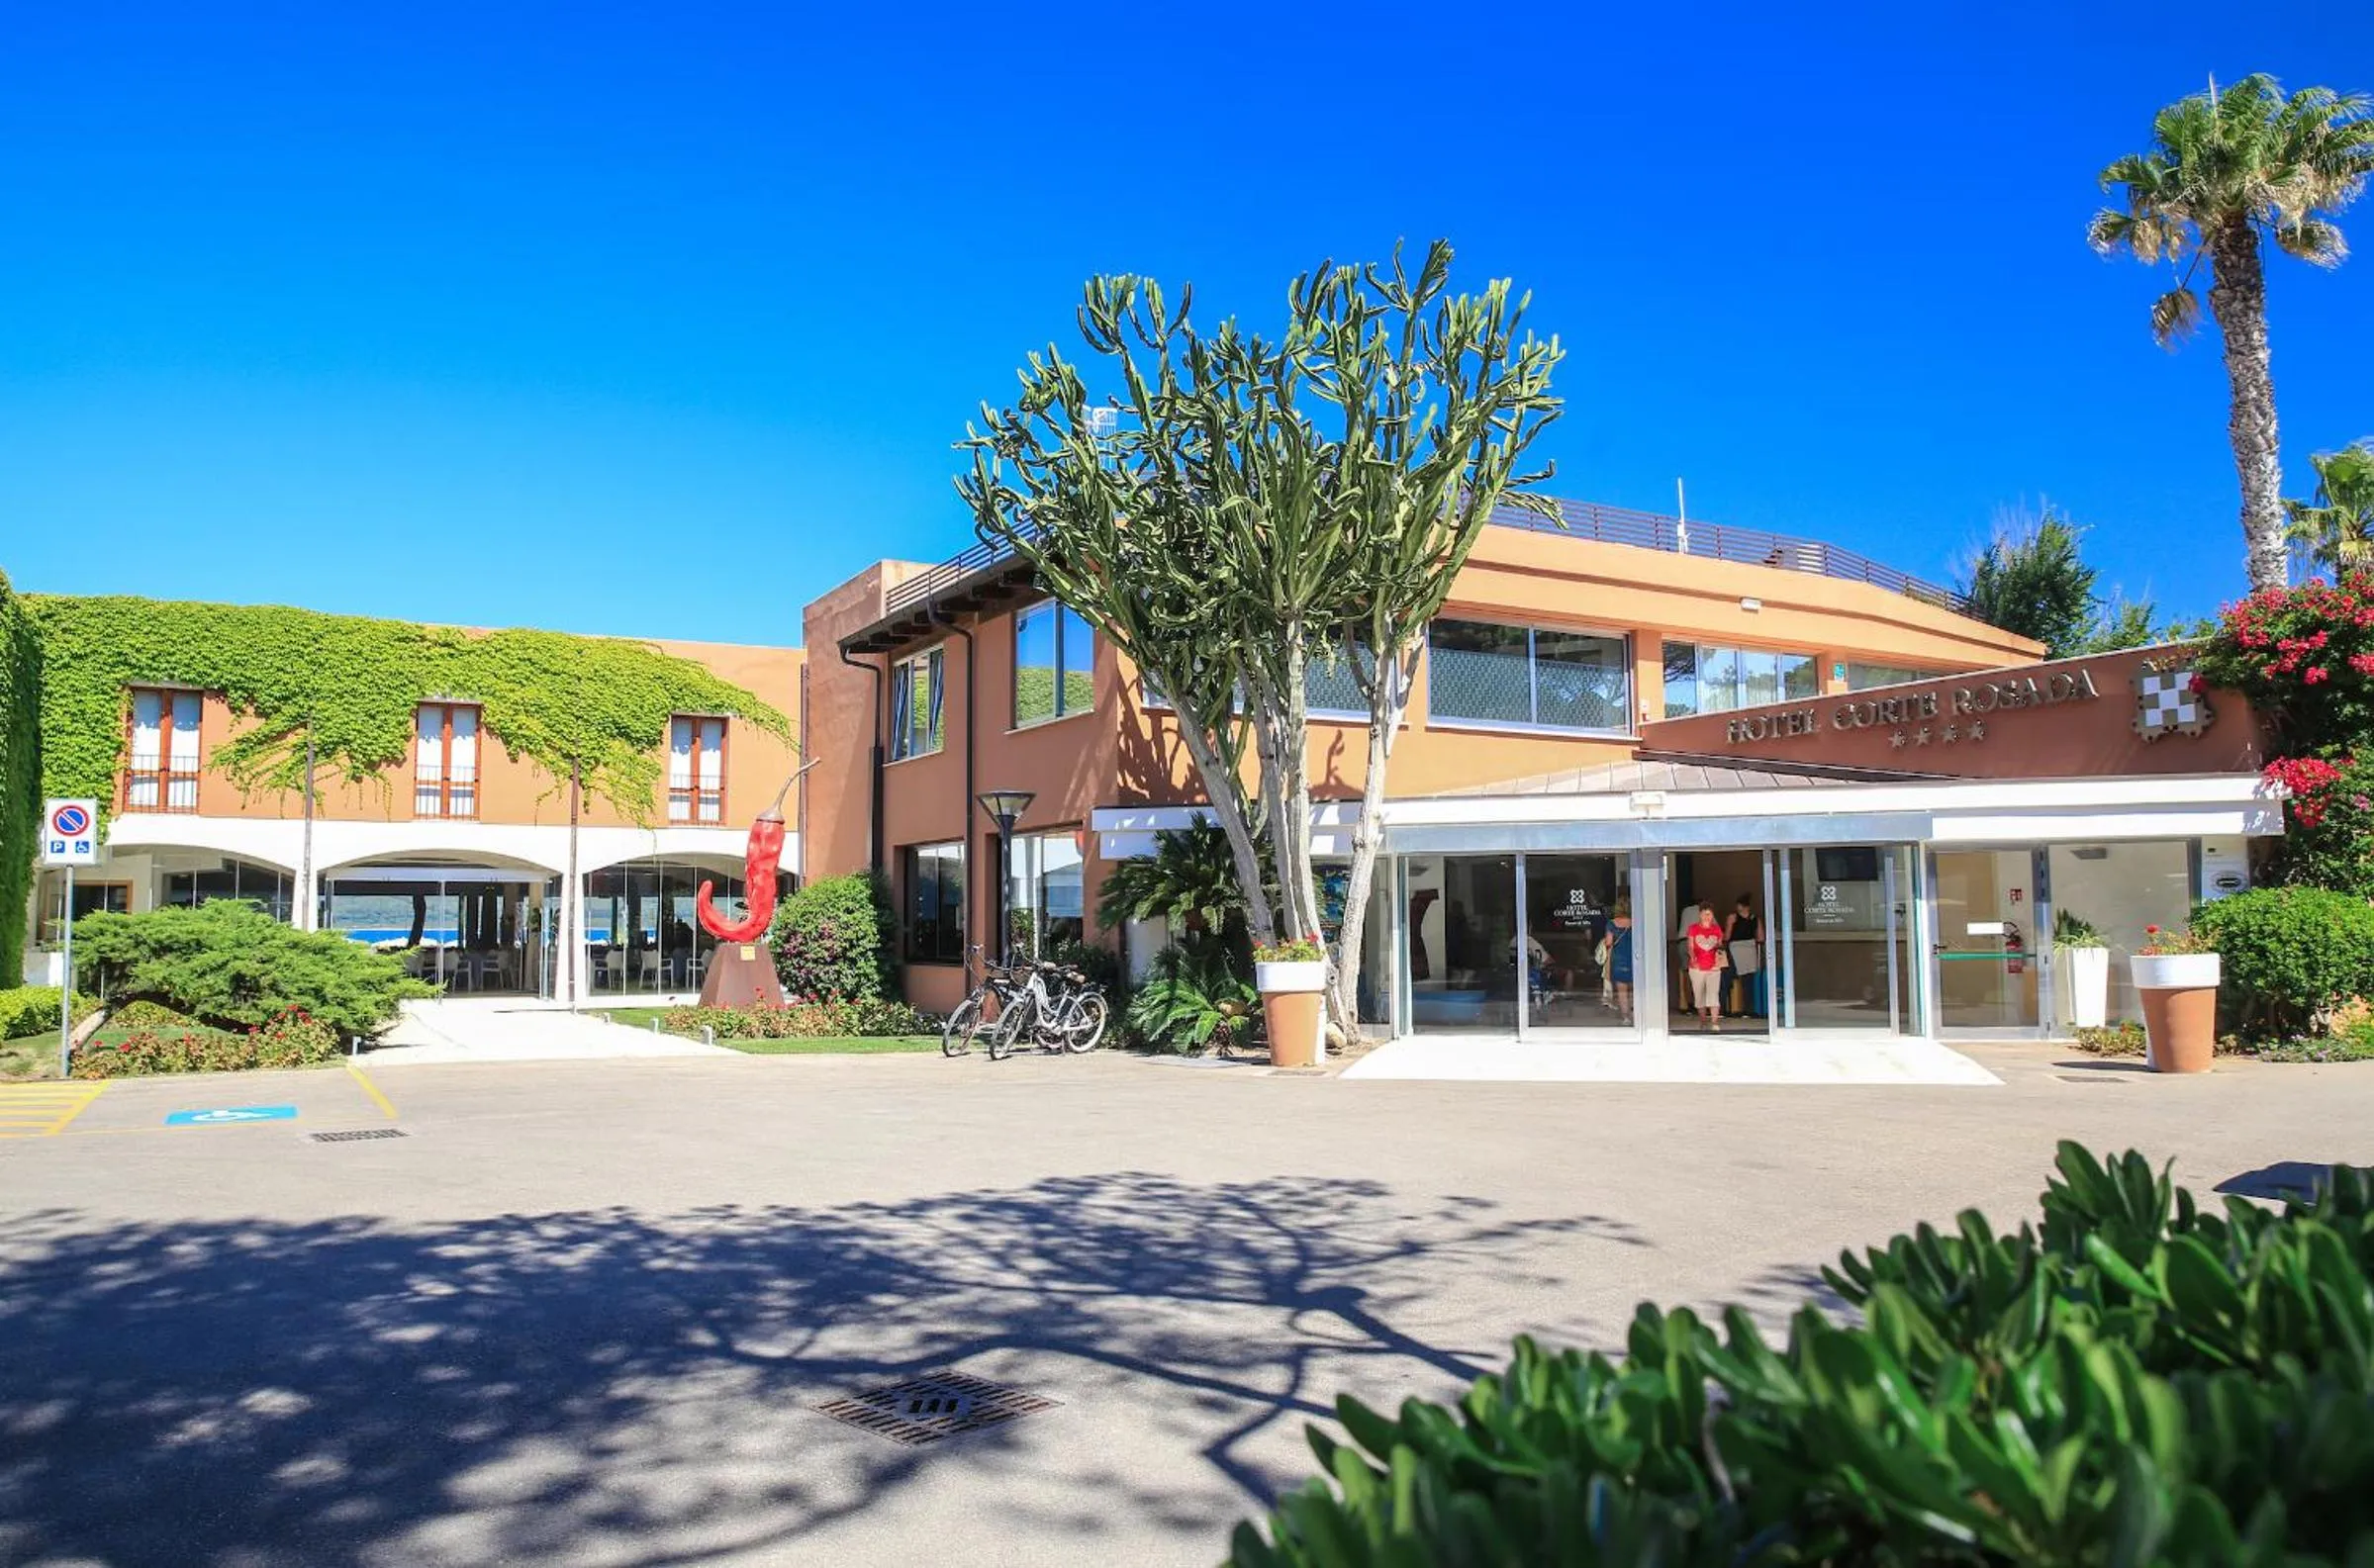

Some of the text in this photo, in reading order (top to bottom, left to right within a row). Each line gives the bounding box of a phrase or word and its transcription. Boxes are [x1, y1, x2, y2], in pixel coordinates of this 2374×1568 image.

[1727, 668, 2099, 743] HOTEL CORTE ROSADA
[53, 843, 62, 852] P
